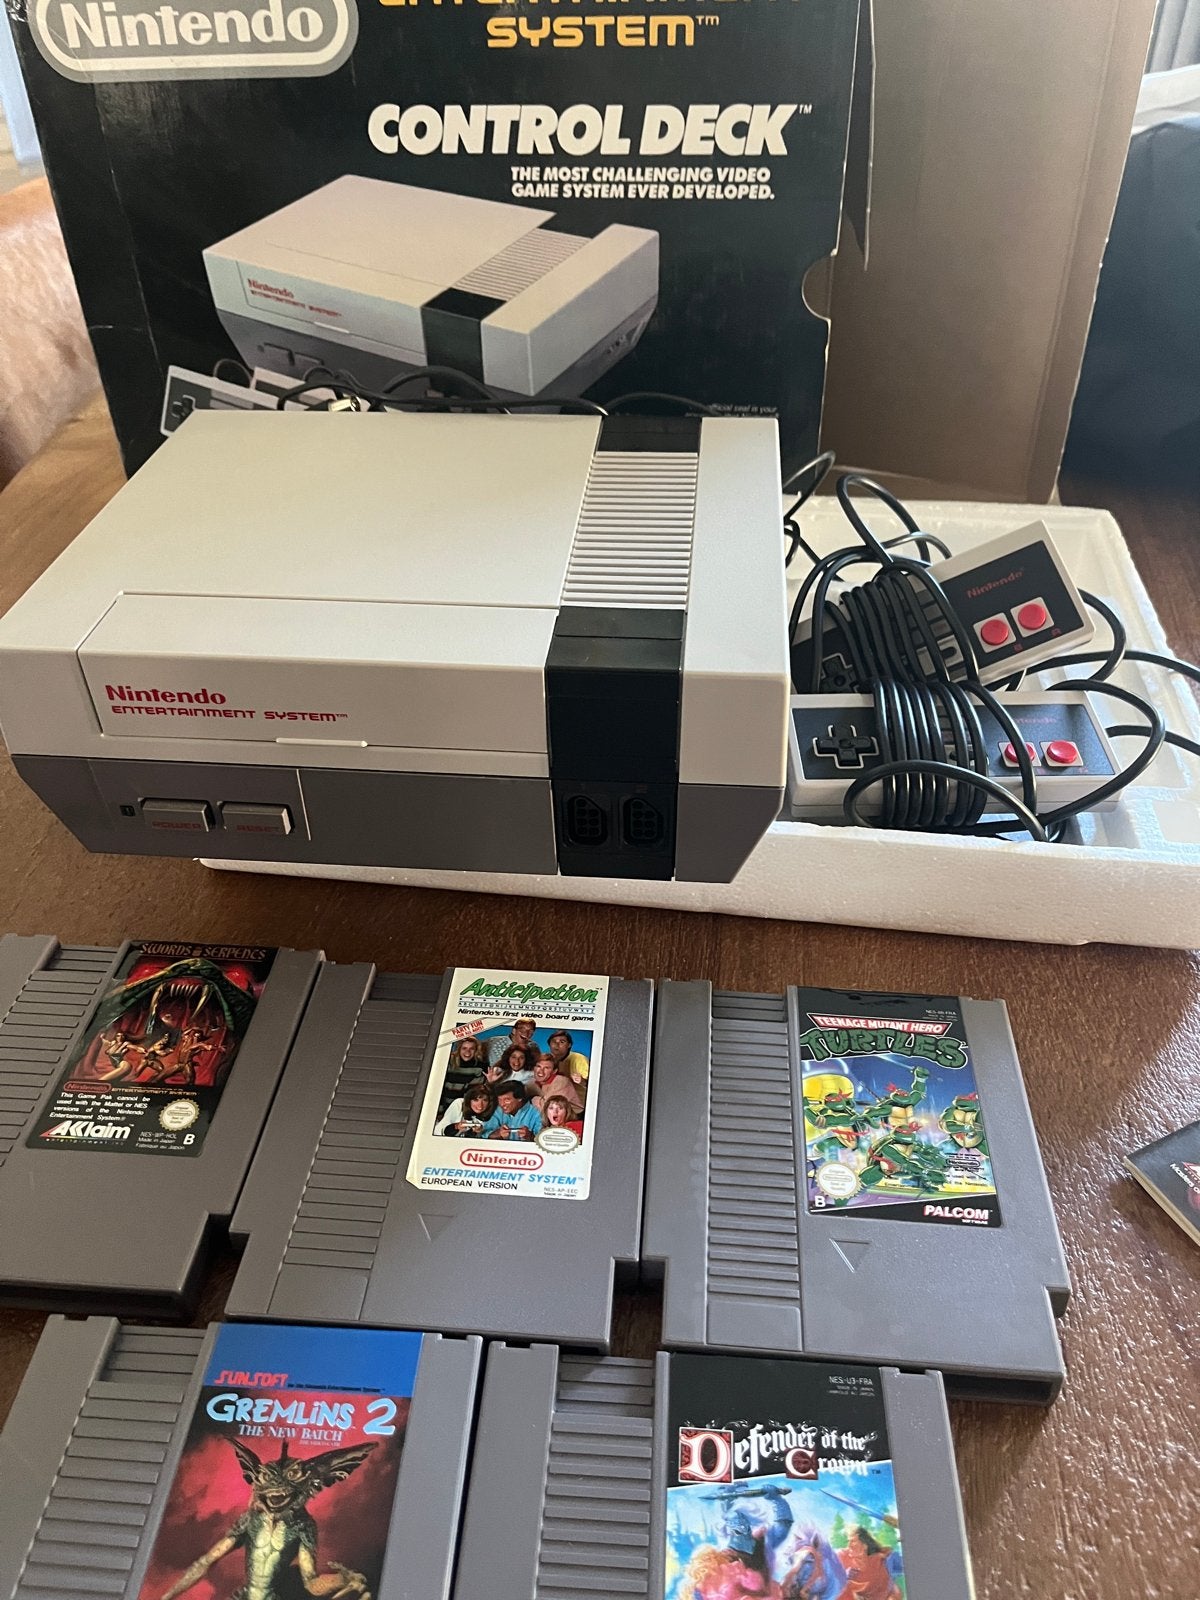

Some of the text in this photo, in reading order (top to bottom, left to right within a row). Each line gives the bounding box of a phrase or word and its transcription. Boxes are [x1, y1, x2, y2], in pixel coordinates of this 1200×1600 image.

[61, 0, 324, 49] Nintendo
[368, 103, 630, 156] CONTROL
[511, 167, 771, 184] THE MOST CHALLENGING VIDEO
[511, 183, 775, 200] GAME SYSTEM EVER DEVELOPED.
[247, 279, 295, 298] Nintendo
[966, 571, 1024, 599] Nintendo
[105, 684, 227, 705] Nintendo
[111, 705, 256, 719] ENTERTAINMENT
[140, 942, 193, 956] SWORDS
[459, 977, 599, 1003] Anticipation
[457, 1008, 595, 1022] Nintendo's first video board game
[814, 1016, 944, 1034] TEENAGE MUTANT HERO
[800, 1028, 968, 1070] TURTLES
[49, 1112, 94, 1120] Entertainment
[117, 1108, 144, 1116] Nintendo
[183, 1133, 195, 1145] B
[466, 1152, 537, 1167] Nintendo
[423, 1166, 525, 1182] ENTERTAINMENT
[421, 1176, 518, 1191] EUROPEAN VERSION
[815, 1195, 826, 1208] B
[923, 1204, 989, 1220] PALCOM
[214, 1370, 289, 1388] SUNSOFT
[363, 1398, 397, 1436] 2
[238, 1424, 343, 1442] THE NEW BATCH
[679, 1423, 868, 1482] Defender of the
